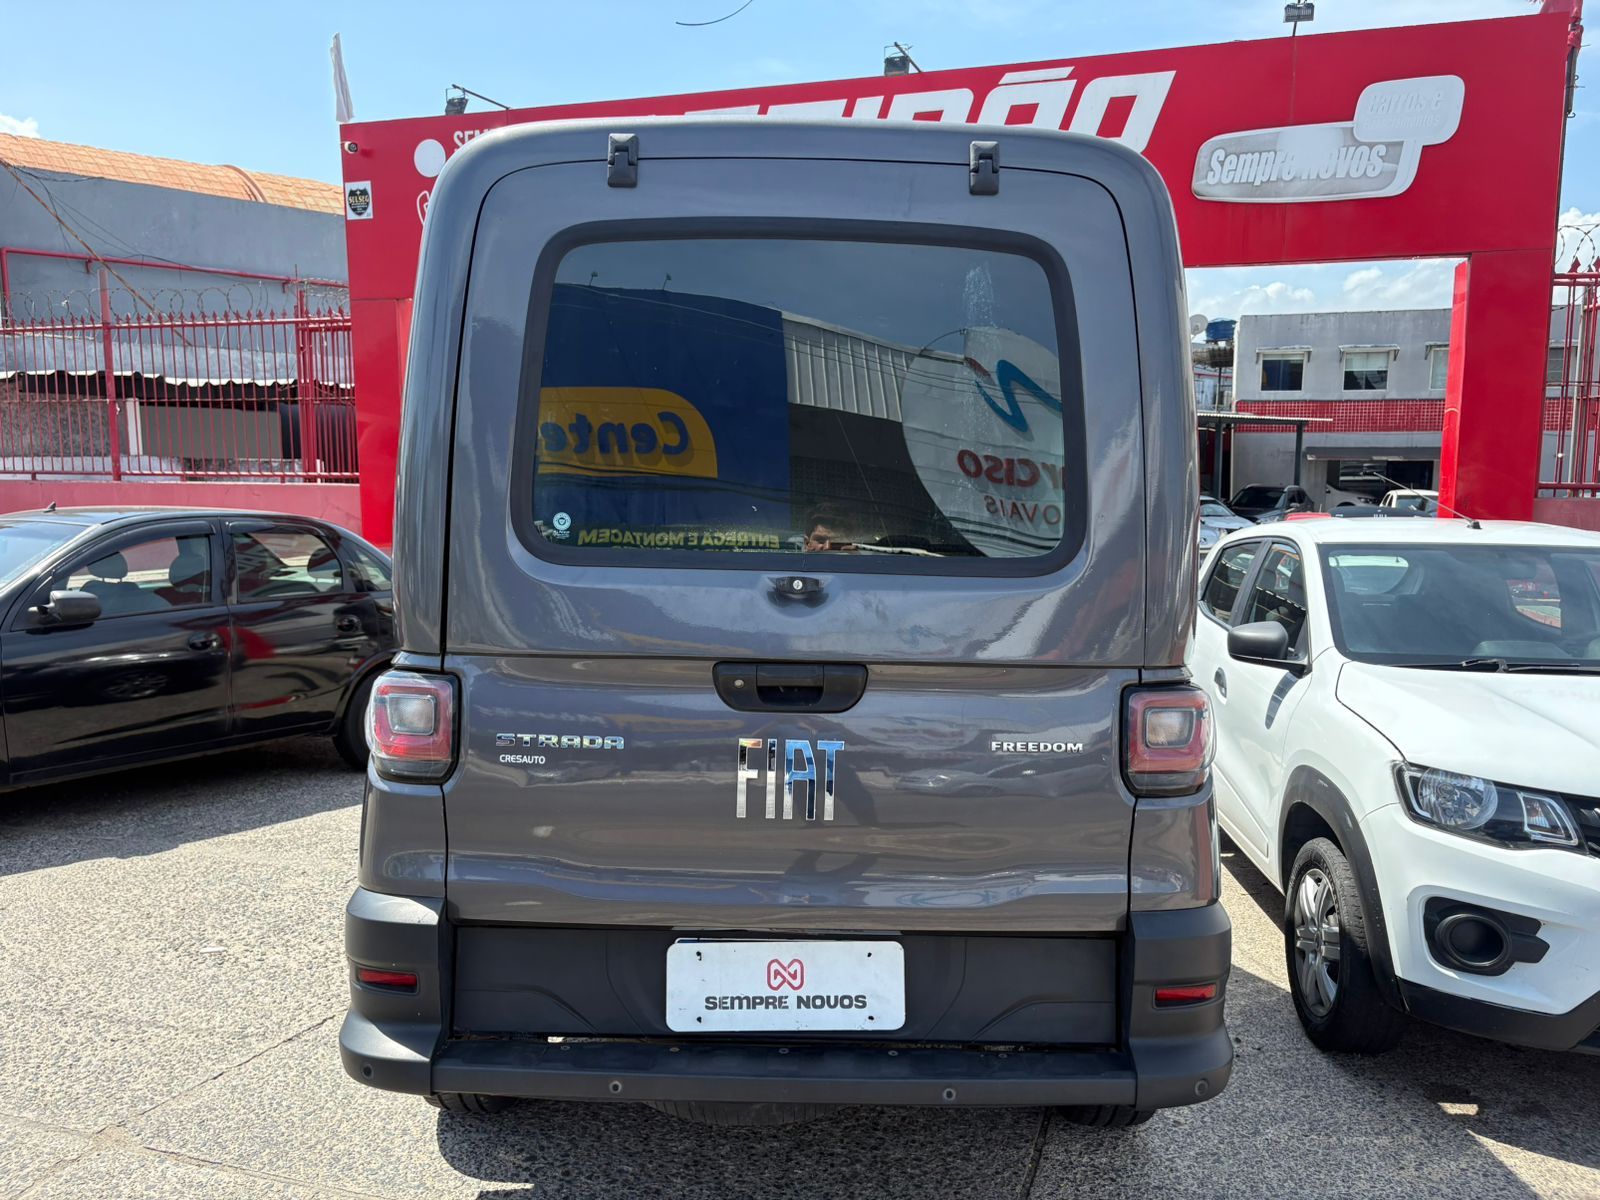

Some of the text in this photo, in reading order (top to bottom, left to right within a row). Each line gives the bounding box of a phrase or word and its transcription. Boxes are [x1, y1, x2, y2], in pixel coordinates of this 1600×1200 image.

[1207, 148, 1297, 186] Sempre
[496, 733, 625, 750] STRADA
[991, 741, 1083, 753] FREEDOM
[499, 754, 546, 764] CRESAUTO
[736, 738, 845, 821] FIAT
[704, 994, 868, 1011] SEMPRE NOVOS
